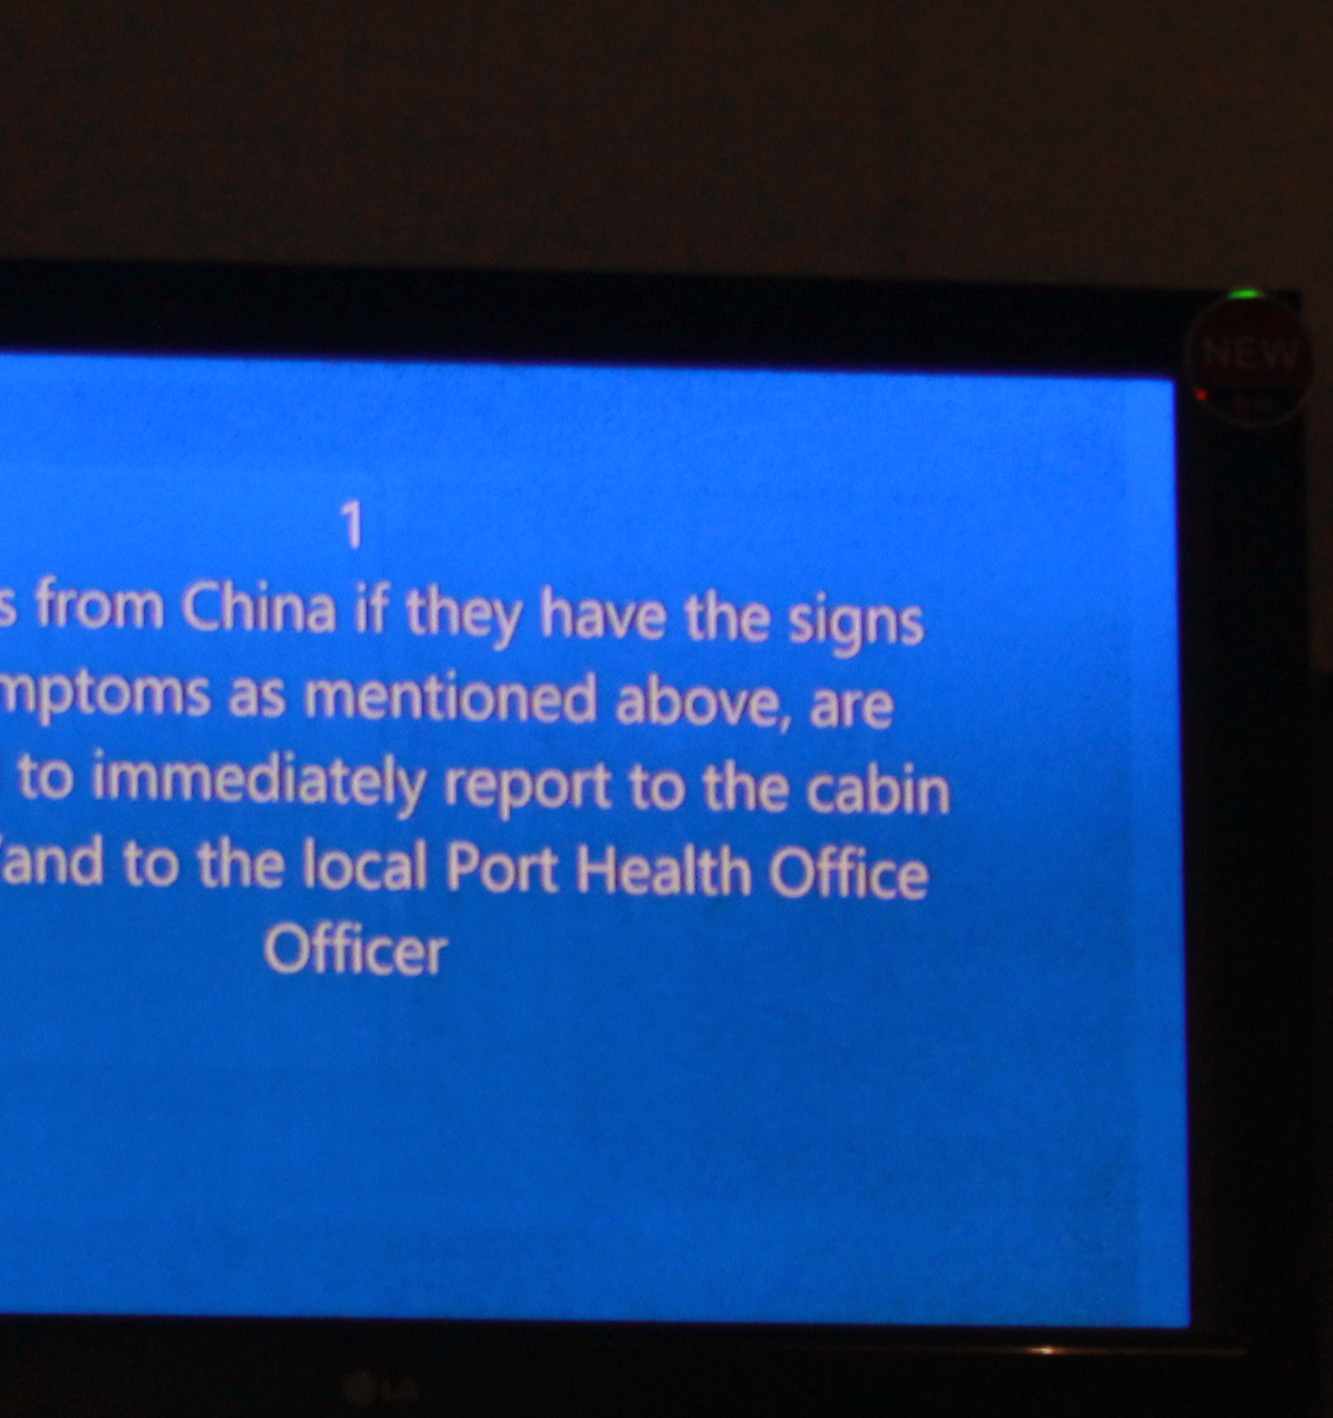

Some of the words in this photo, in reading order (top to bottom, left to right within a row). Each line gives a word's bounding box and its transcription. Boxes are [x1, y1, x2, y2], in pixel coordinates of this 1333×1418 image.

[1202, 335, 1300, 370] NEW
[341, 500, 360, 549] 1
[34, 574, 164, 630] from
[181, 578, 337, 634] China
[354, 580, 391, 633] if
[405, 583, 524, 652] they
[540, 584, 668, 641] have
[683, 588, 772, 643] the
[788, 591, 925, 660] signs
[228, 676, 286, 718] as
[304, 669, 597, 724] mentioned
[615, 672, 791, 733] above,
[809, 687, 895, 730] are
[17, 752, 74, 800] to
[92, 747, 427, 821] immediately
[445, 761, 612, 822] report
[628, 763, 686, 811] to
[702, 758, 790, 813] the
[806, 762, 950, 815] cabin
[123, 840, 179, 887] to
[196, 835, 285, 889] the
[303, 837, 428, 891] local
[447, 840, 559, 893] Port
[577, 843, 753, 896] Health
[769, 844, 929, 900] Office
[264, 919, 448, 976] Officer
